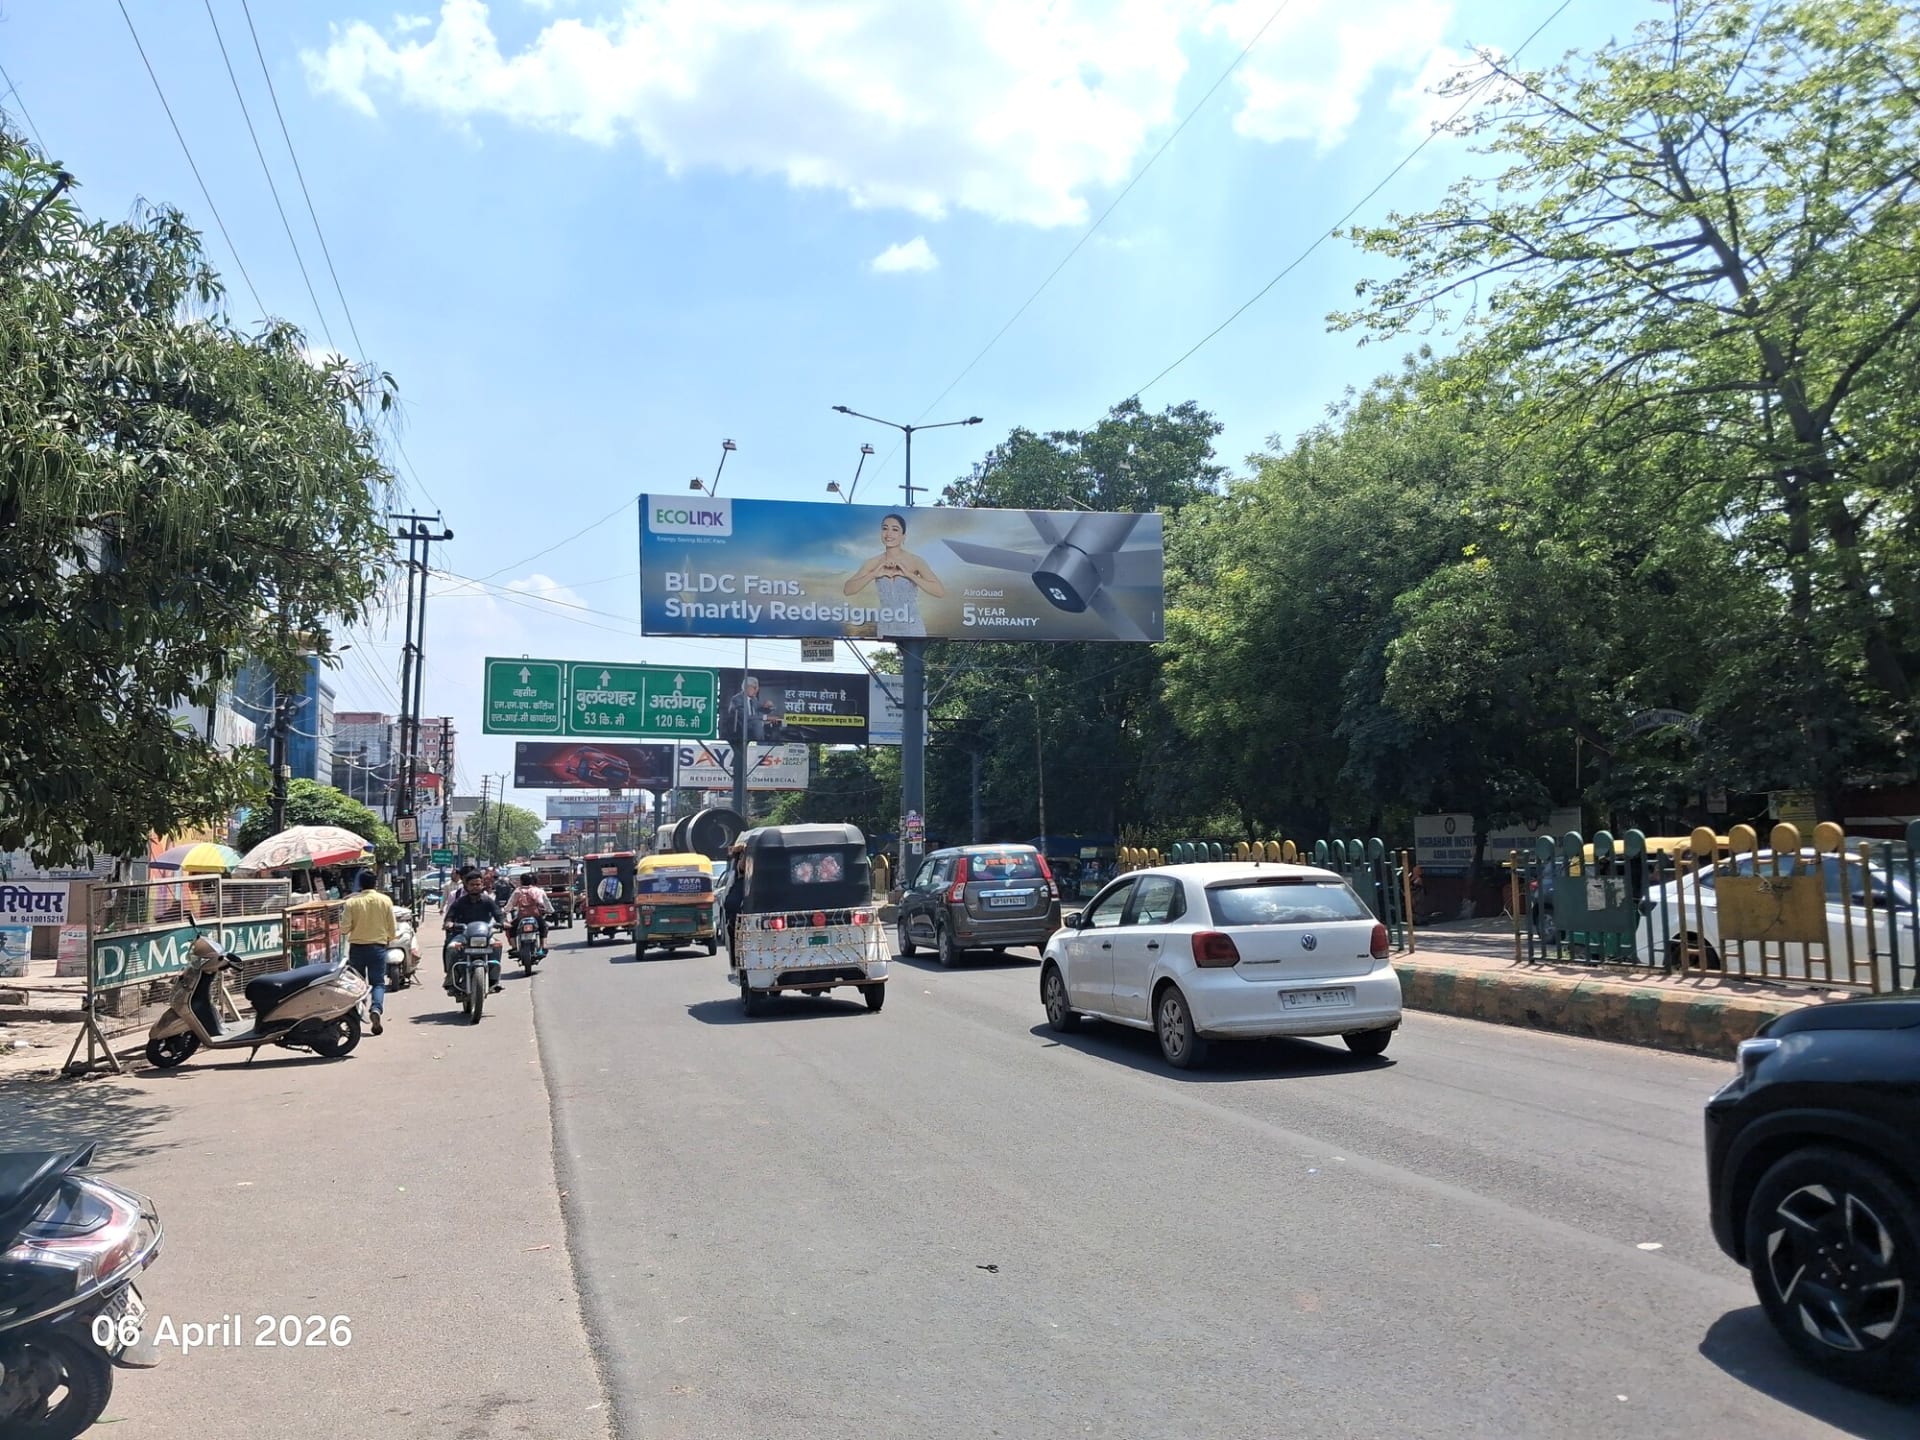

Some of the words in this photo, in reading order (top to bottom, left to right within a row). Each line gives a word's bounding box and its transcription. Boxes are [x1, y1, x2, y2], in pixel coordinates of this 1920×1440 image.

[656, 509, 724, 527] ECOLINK
[665, 572, 736, 593] BLDC
[744, 575, 806, 596] Fans.
[665, 598, 762, 623] Smartly
[770, 601, 914, 626] Redesigned.
[962, 606, 976, 626] 5
[977, 607, 1005, 617] YEAR
[576, 685, 638, 711] बुलंदशहर
[649, 690, 708, 714] अलीगढ़
[784, 690, 796, 699] हर
[798, 690, 817, 699] समय
[820, 688, 838, 701] होता
[840, 689, 847, 701] है
[784, 699, 806, 713] सही
[584, 712, 596, 725] 53
[655, 715, 673, 727] 120
[680, 747, 734, 768] SAY
